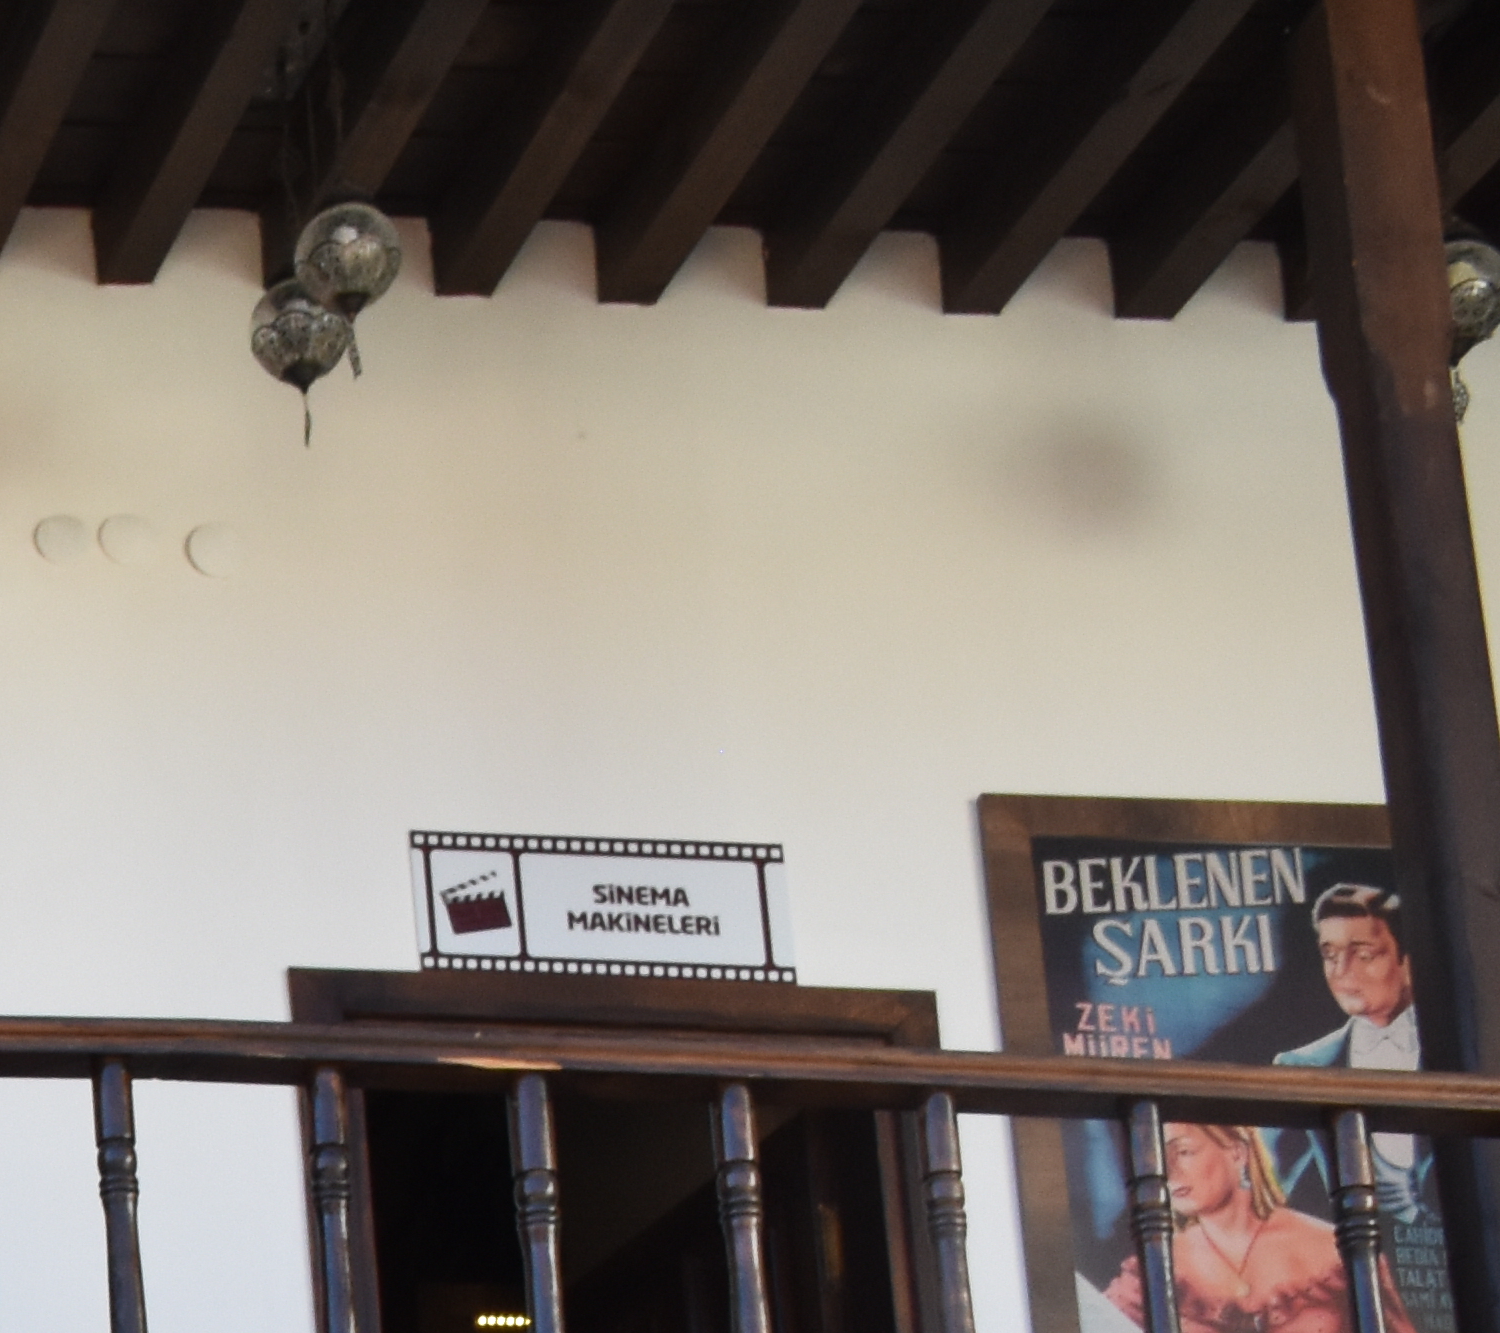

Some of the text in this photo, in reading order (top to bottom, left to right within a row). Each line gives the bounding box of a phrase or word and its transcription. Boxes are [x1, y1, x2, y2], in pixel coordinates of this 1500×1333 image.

[592, 884, 689, 907] SİNEMA
[1043, 847, 1307, 915] BEKLENEN
[567, 910, 720, 936] MAKİNELERİ
[1092, 913, 1276, 986] ŞARKI
